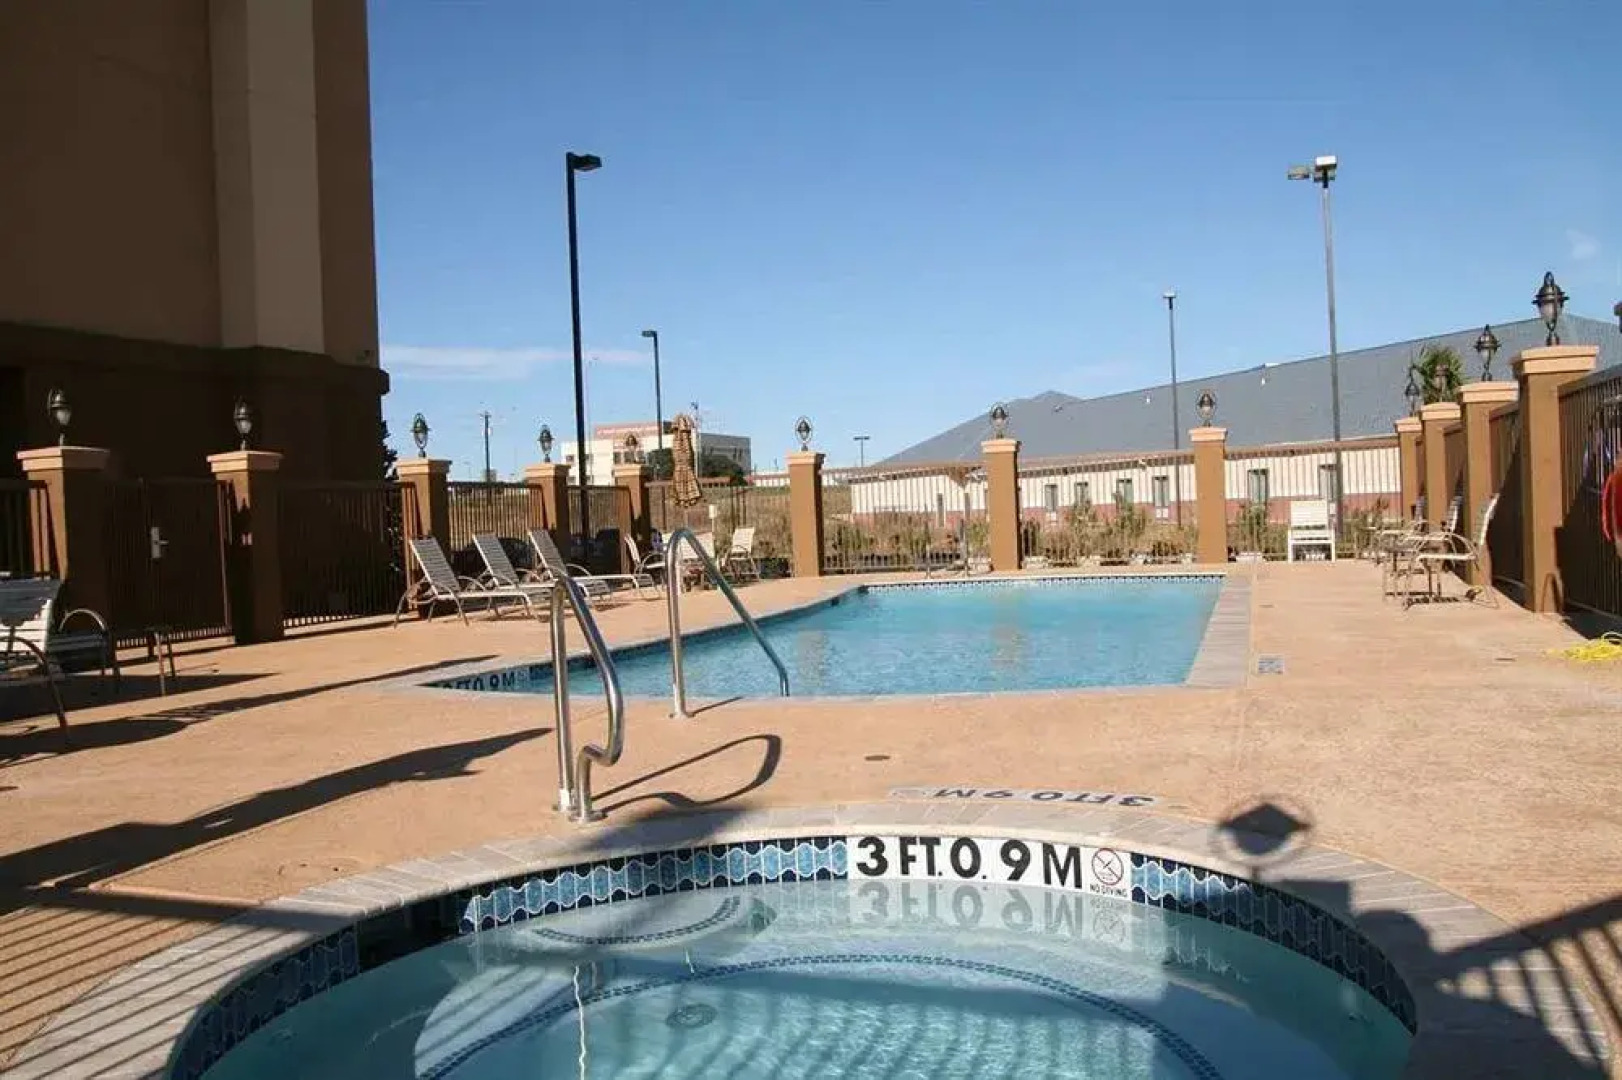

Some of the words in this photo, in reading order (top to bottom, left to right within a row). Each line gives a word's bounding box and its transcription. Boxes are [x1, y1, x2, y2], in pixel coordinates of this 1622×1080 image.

[856, 836, 889, 877] 3
[1042, 842, 1083, 889] M
[1089, 883, 1101, 893] NO
[1101, 885, 1128, 898] DIVING
